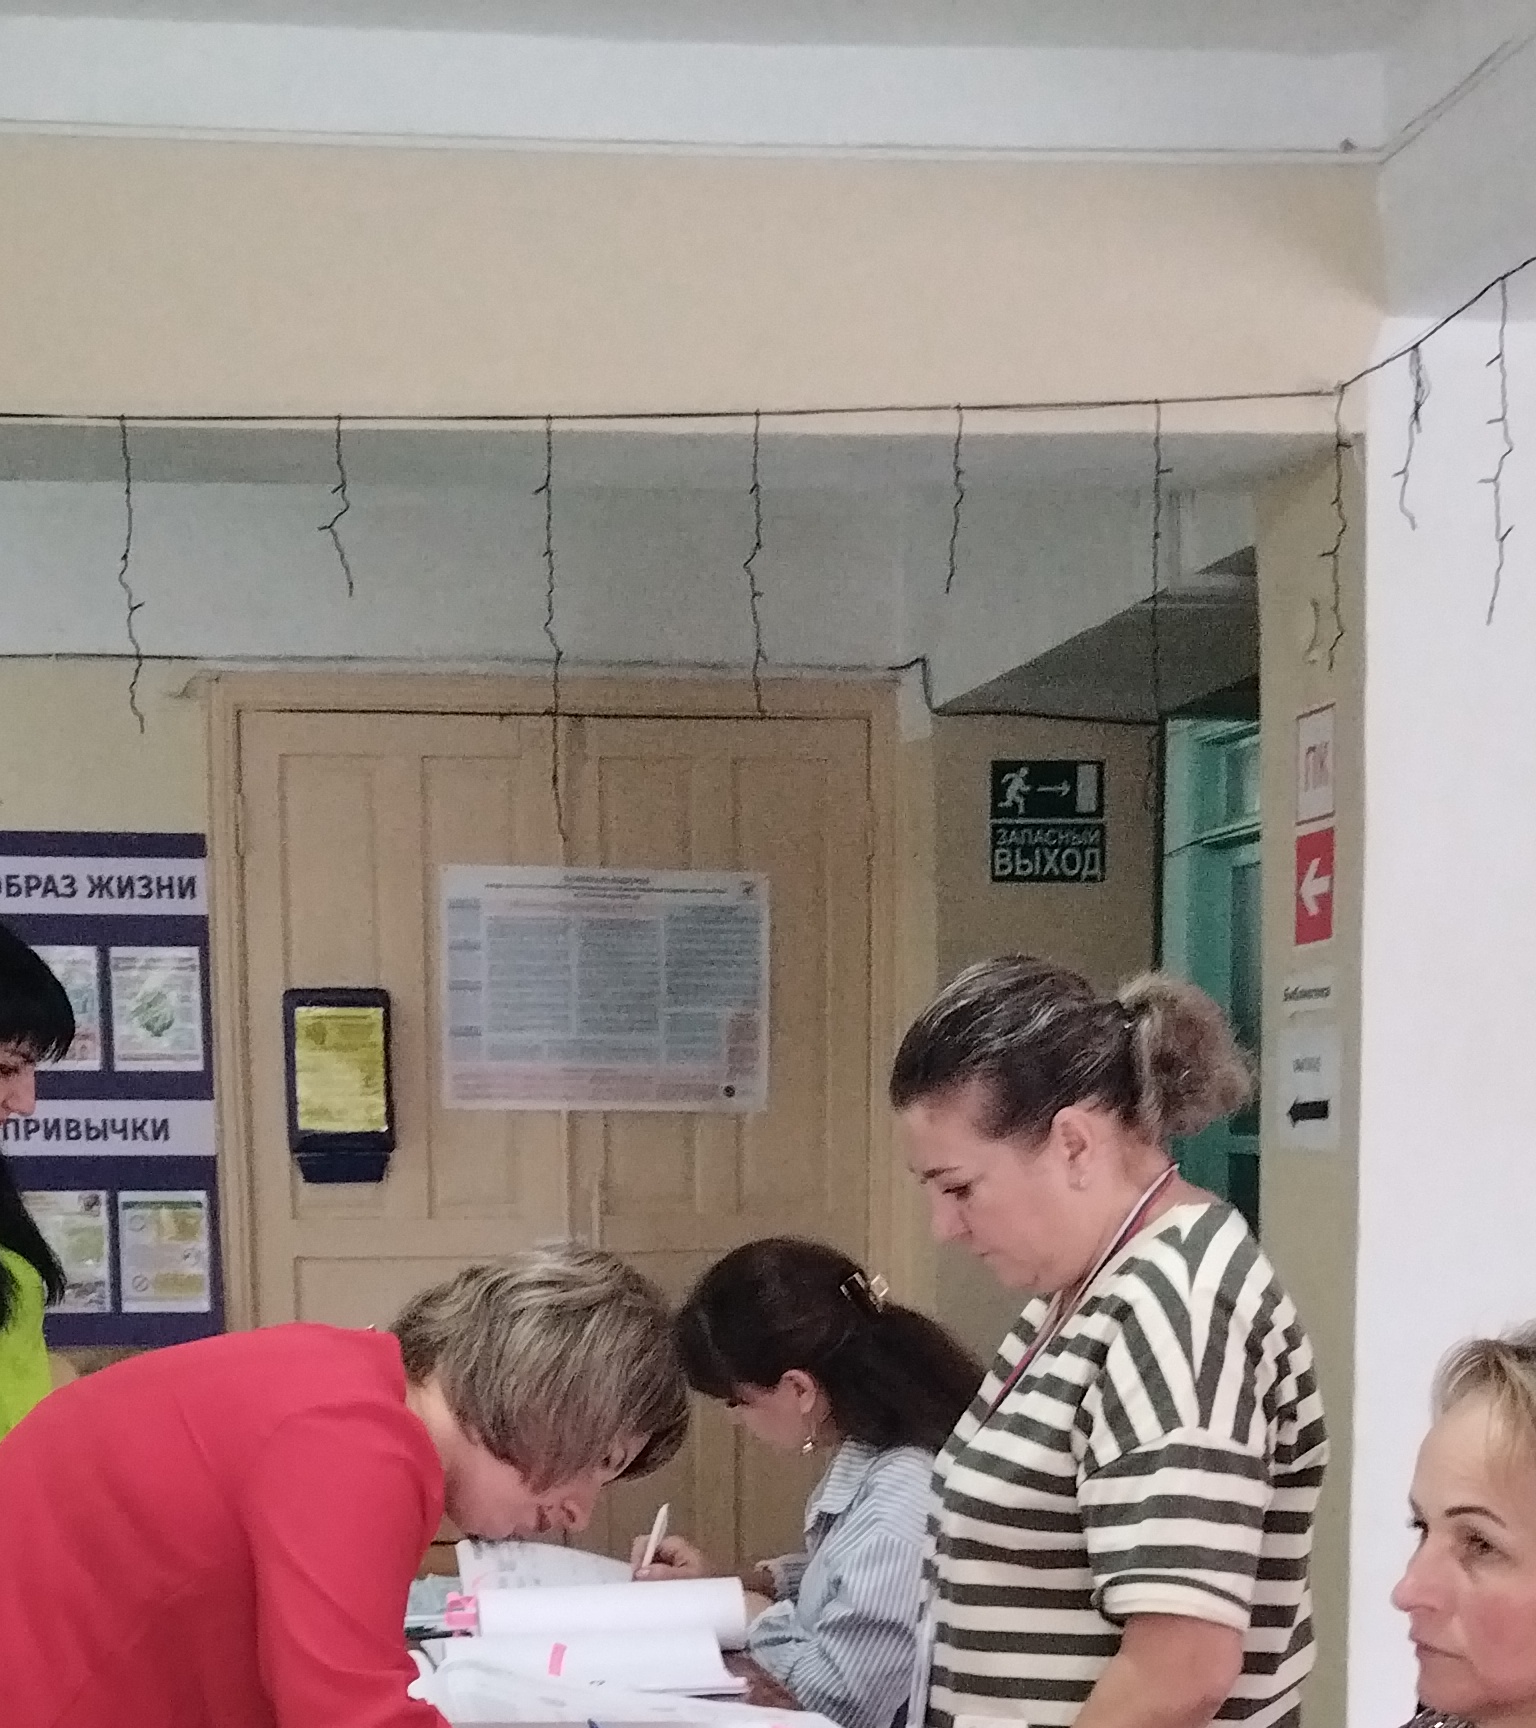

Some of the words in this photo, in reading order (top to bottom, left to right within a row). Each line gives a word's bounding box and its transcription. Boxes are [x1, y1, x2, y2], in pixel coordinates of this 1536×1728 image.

[996, 828, 1101, 846] ЗАПАСНЫЙ
[994, 847, 1102, 881] ВЫХОД
[86, 872, 197, 900] ЖИЗНИ
[3, 1117, 171, 1142] ПРИВЫЧКИ
